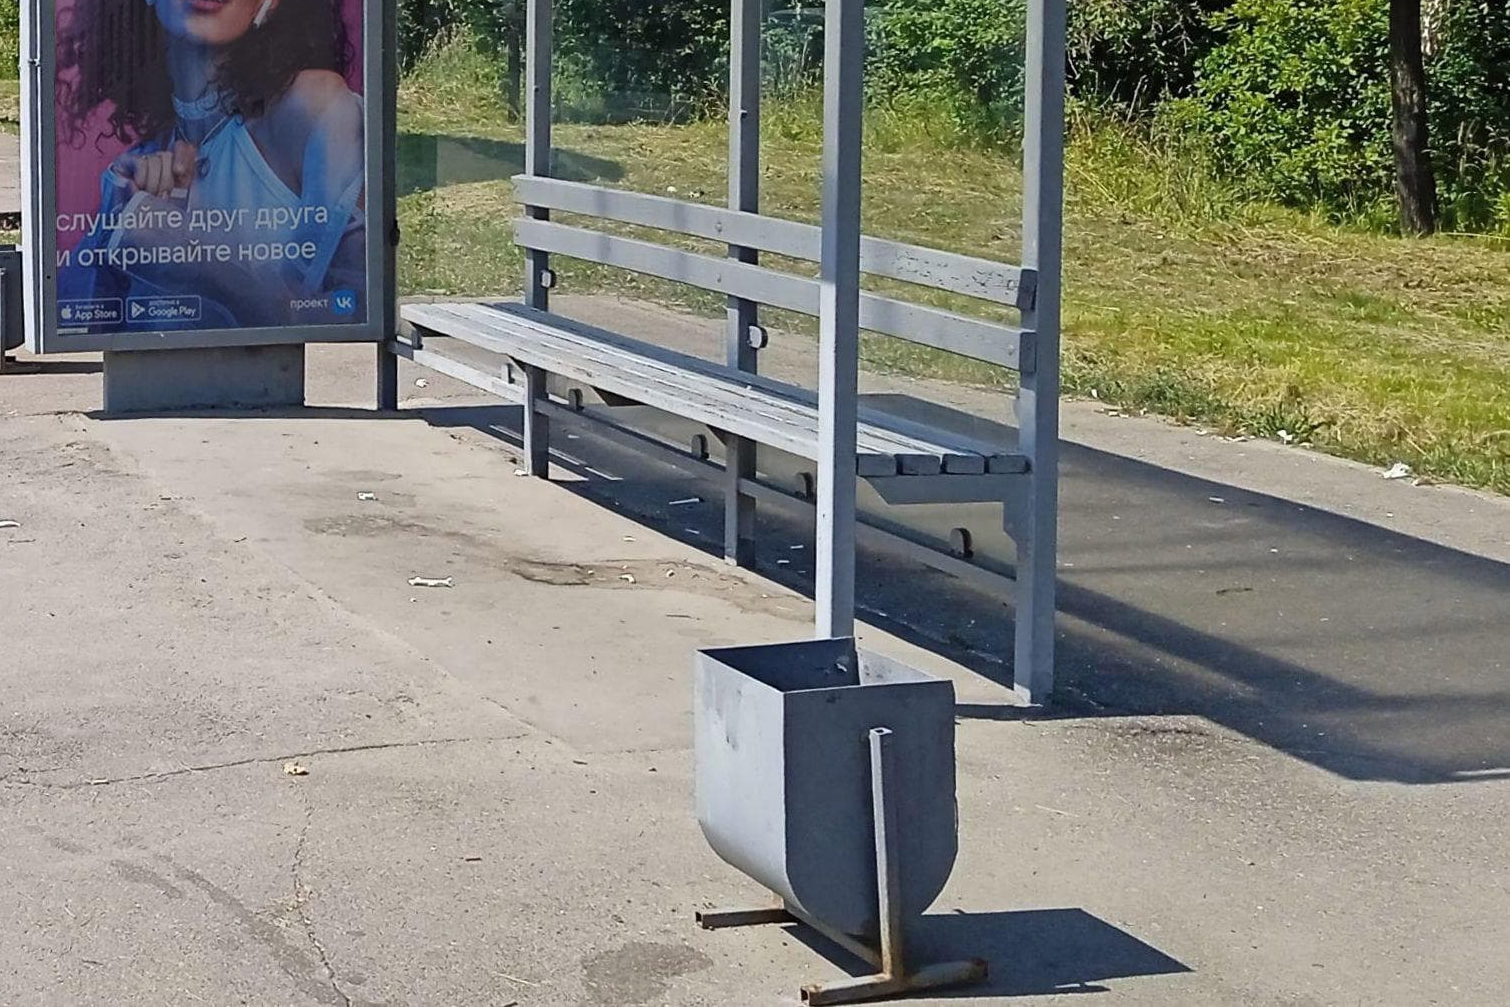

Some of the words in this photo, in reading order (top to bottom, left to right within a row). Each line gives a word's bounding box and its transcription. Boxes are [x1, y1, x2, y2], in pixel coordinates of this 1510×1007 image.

[56, 206, 183, 237] слушайте
[189, 207, 250, 233] друг
[255, 206, 329, 231] друга
[57, 250, 70, 267] и
[78, 240, 231, 271] открывайте
[239, 241, 317, 261] новое
[290, 298, 329, 312] проект
[336, 296, 353, 309] VK
[75, 311, 93, 321] App
[94, 309, 118, 319] Store
[148, 307, 179, 318] Google
[179, 305, 196, 317] Play
